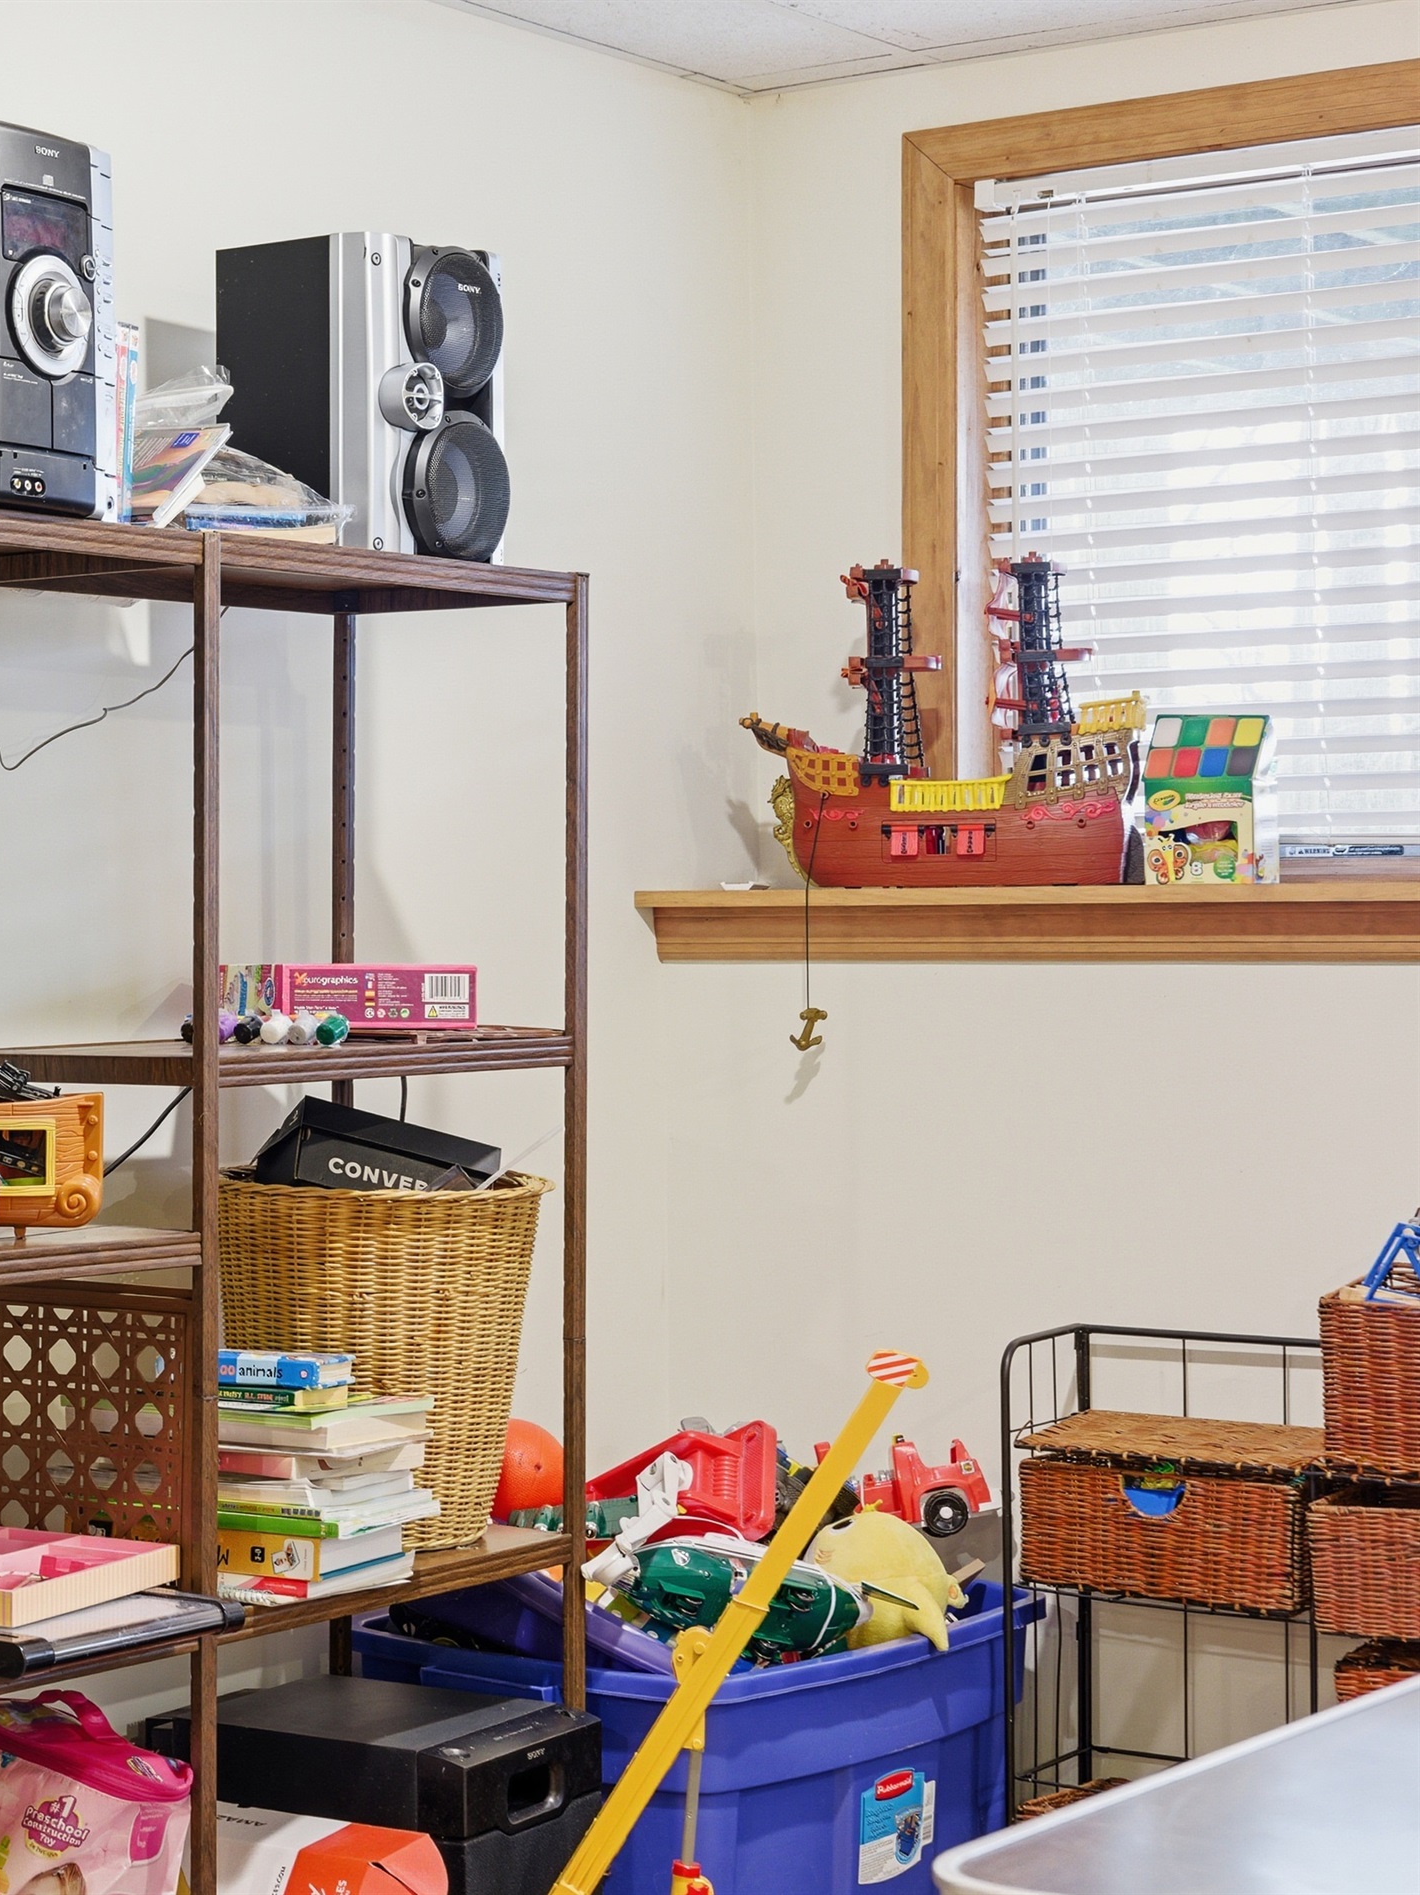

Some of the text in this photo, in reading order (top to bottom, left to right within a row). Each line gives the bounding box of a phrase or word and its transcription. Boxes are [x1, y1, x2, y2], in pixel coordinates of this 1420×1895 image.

[35, 145, 60, 158] SONY
[458, 284, 481, 294] SONY
[1191, 862, 1203, 877] 8
[239, 1364, 283, 1378] animals
[527, 1748, 546, 1760] SONY
[49, 1796, 76, 1818] #1
[25, 1805, 90, 1841] Preschool
[23, 1817, 82, 1847] Construction
[39, 1833, 57, 1848] Toy
